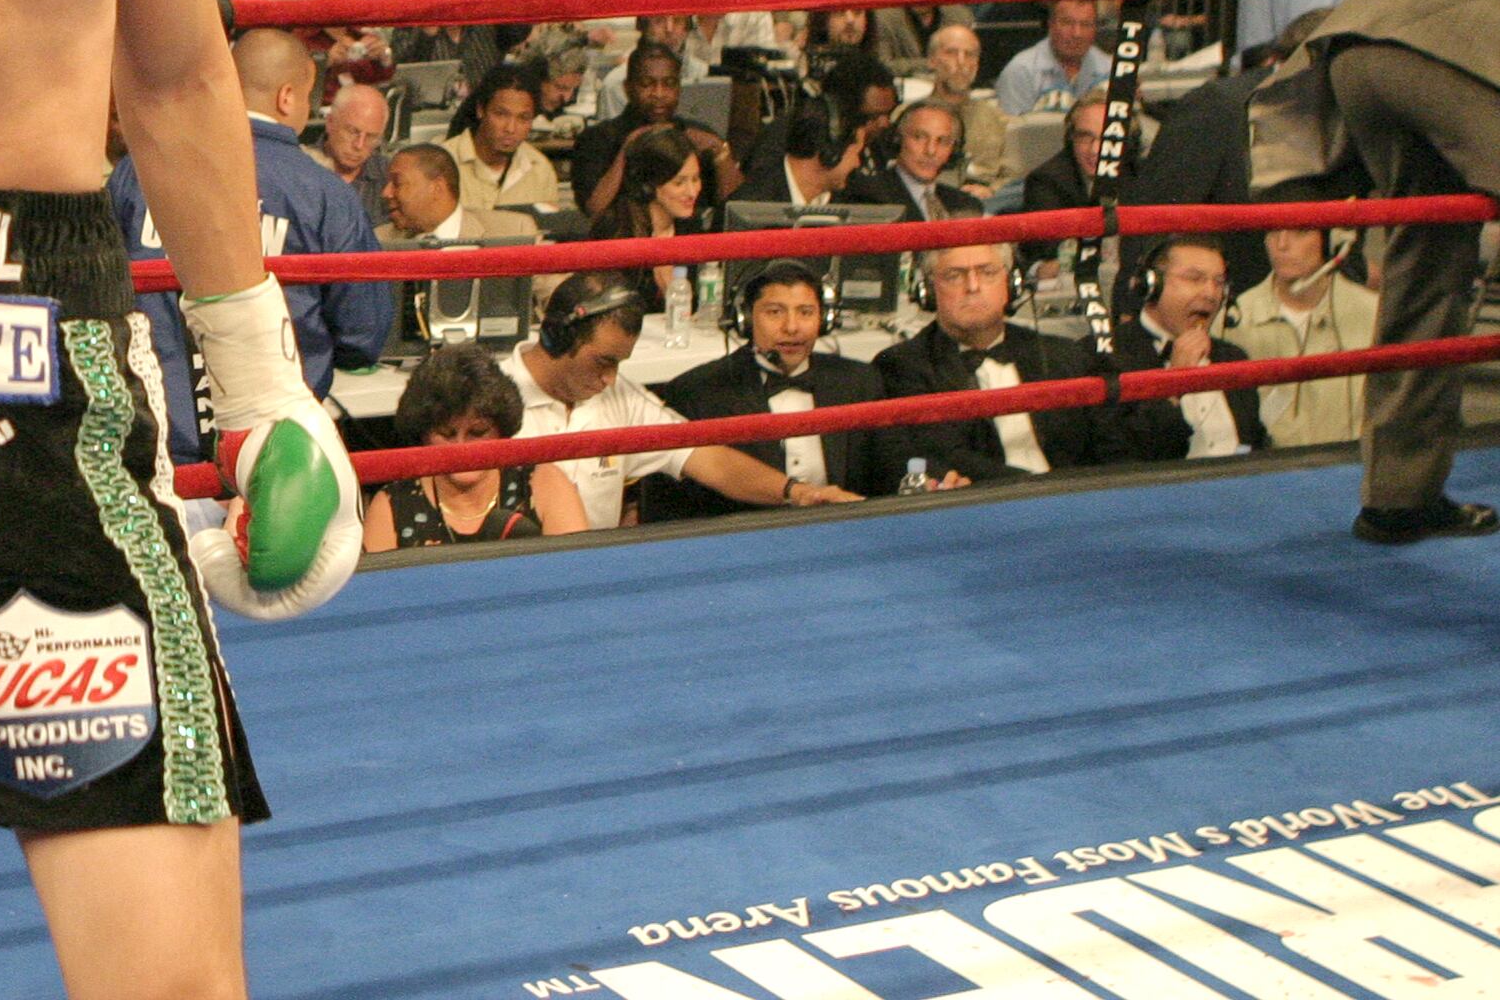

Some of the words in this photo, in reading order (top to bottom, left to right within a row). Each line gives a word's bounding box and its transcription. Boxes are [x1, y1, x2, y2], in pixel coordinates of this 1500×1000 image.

[1115, 21, 1143, 78] TOP
[1097, 100, 1130, 178] RANK
[1079, 281, 1114, 353] RANK
[36, 635, 142, 655] PERFORMANCE
[14, 755, 74, 781] INC.
[1392, 781, 1500, 811] The
[1195, 800, 1405, 848] World's
[1054, 830, 1204, 874] Most
[826, 856, 1061, 912] Famous
[626, 896, 810, 946] Arena
[522, 974, 601, 999] TM
